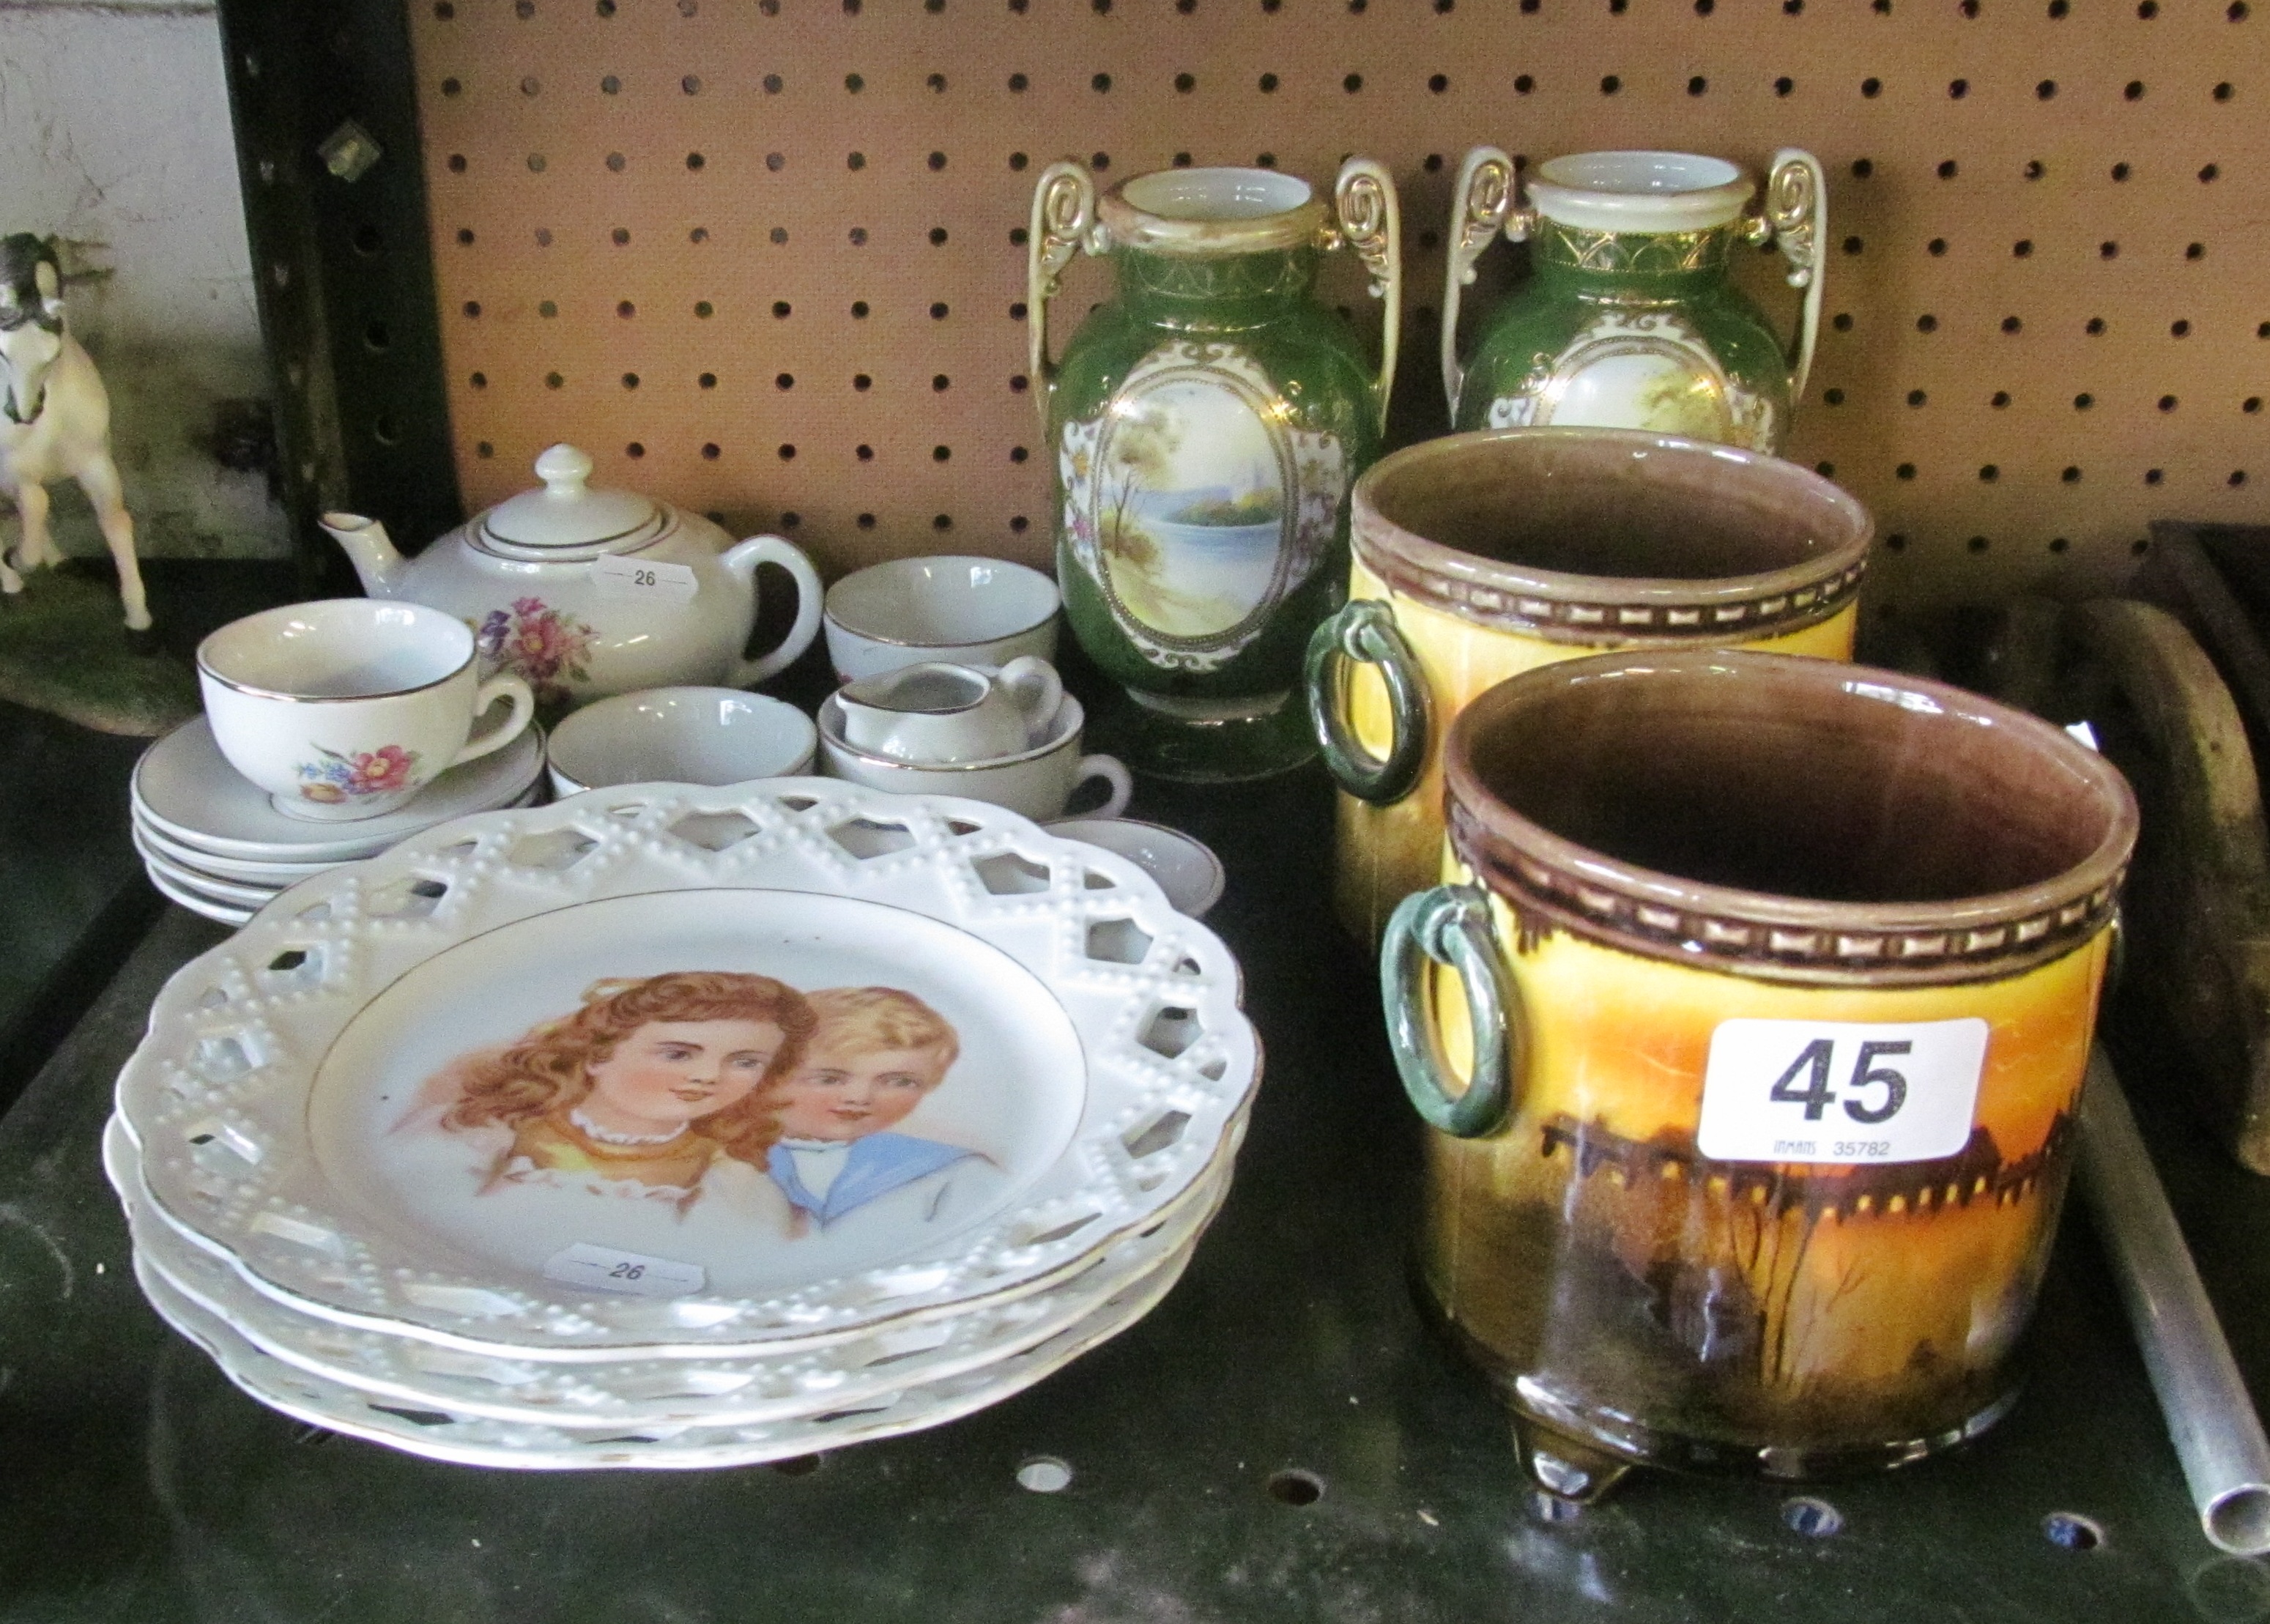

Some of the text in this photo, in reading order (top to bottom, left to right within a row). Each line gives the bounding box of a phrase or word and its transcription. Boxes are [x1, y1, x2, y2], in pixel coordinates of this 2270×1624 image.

[634, 570, 656, 586] 26
[1770, 1039, 1913, 1124] 45
[1833, 1141, 1891, 1157] 35782
[609, 1262, 645, 1280] 26
